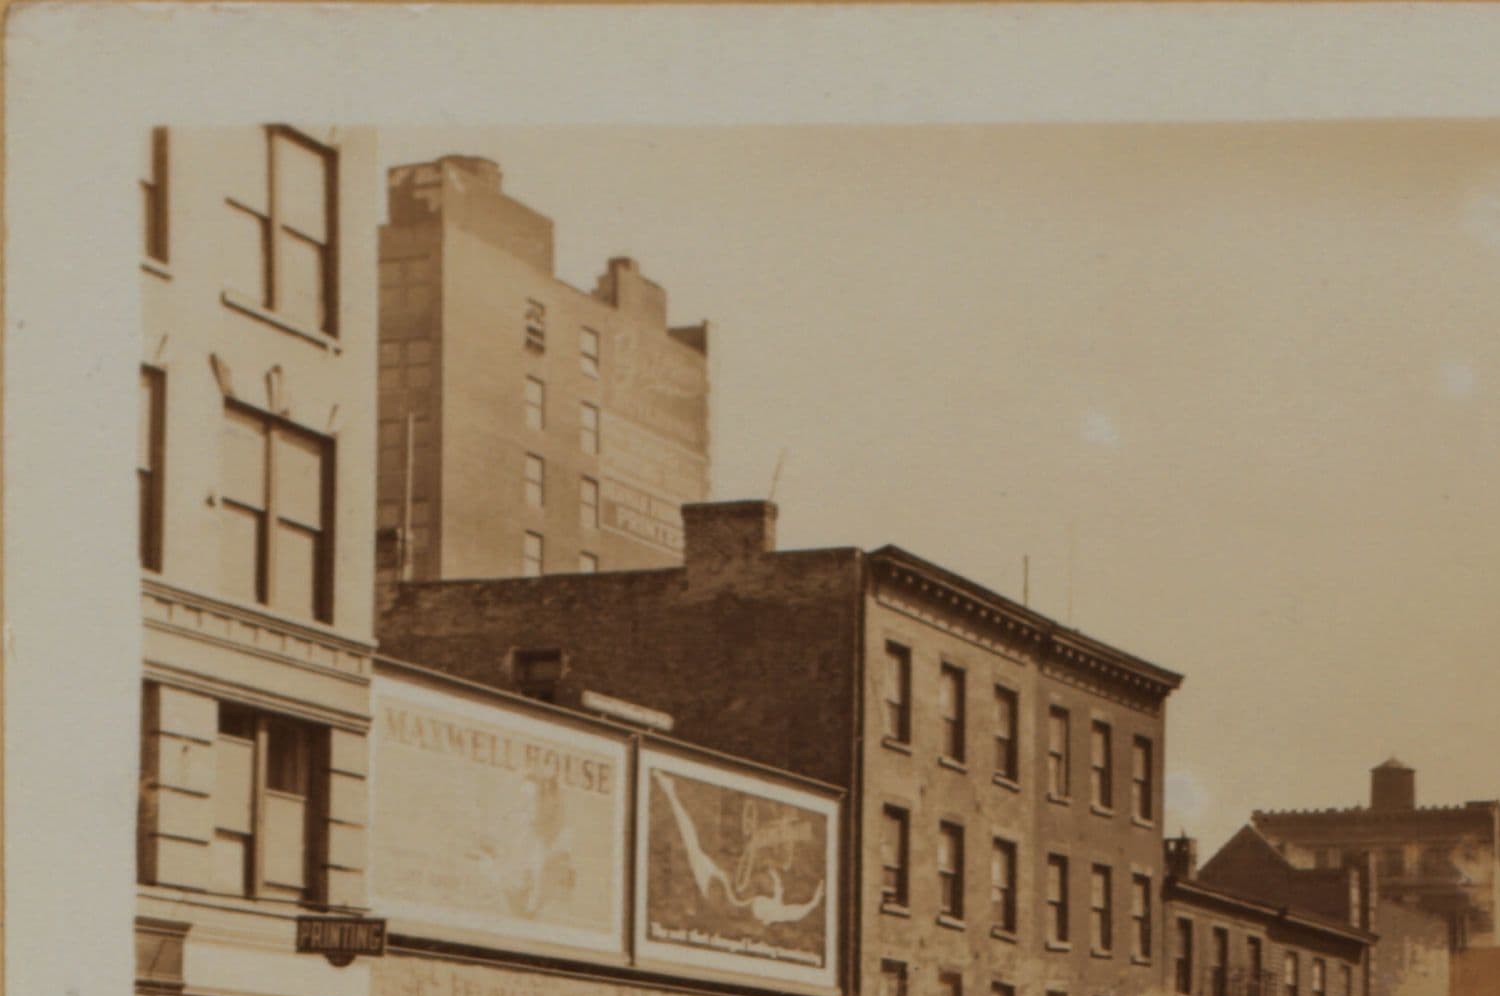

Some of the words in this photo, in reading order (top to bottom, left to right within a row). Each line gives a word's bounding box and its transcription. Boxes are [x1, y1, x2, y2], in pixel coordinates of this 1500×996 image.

[383, 707, 516, 773] MAXWELL
[525, 743, 611, 795] HOUSE
[300, 919, 382, 950] PRINTING
